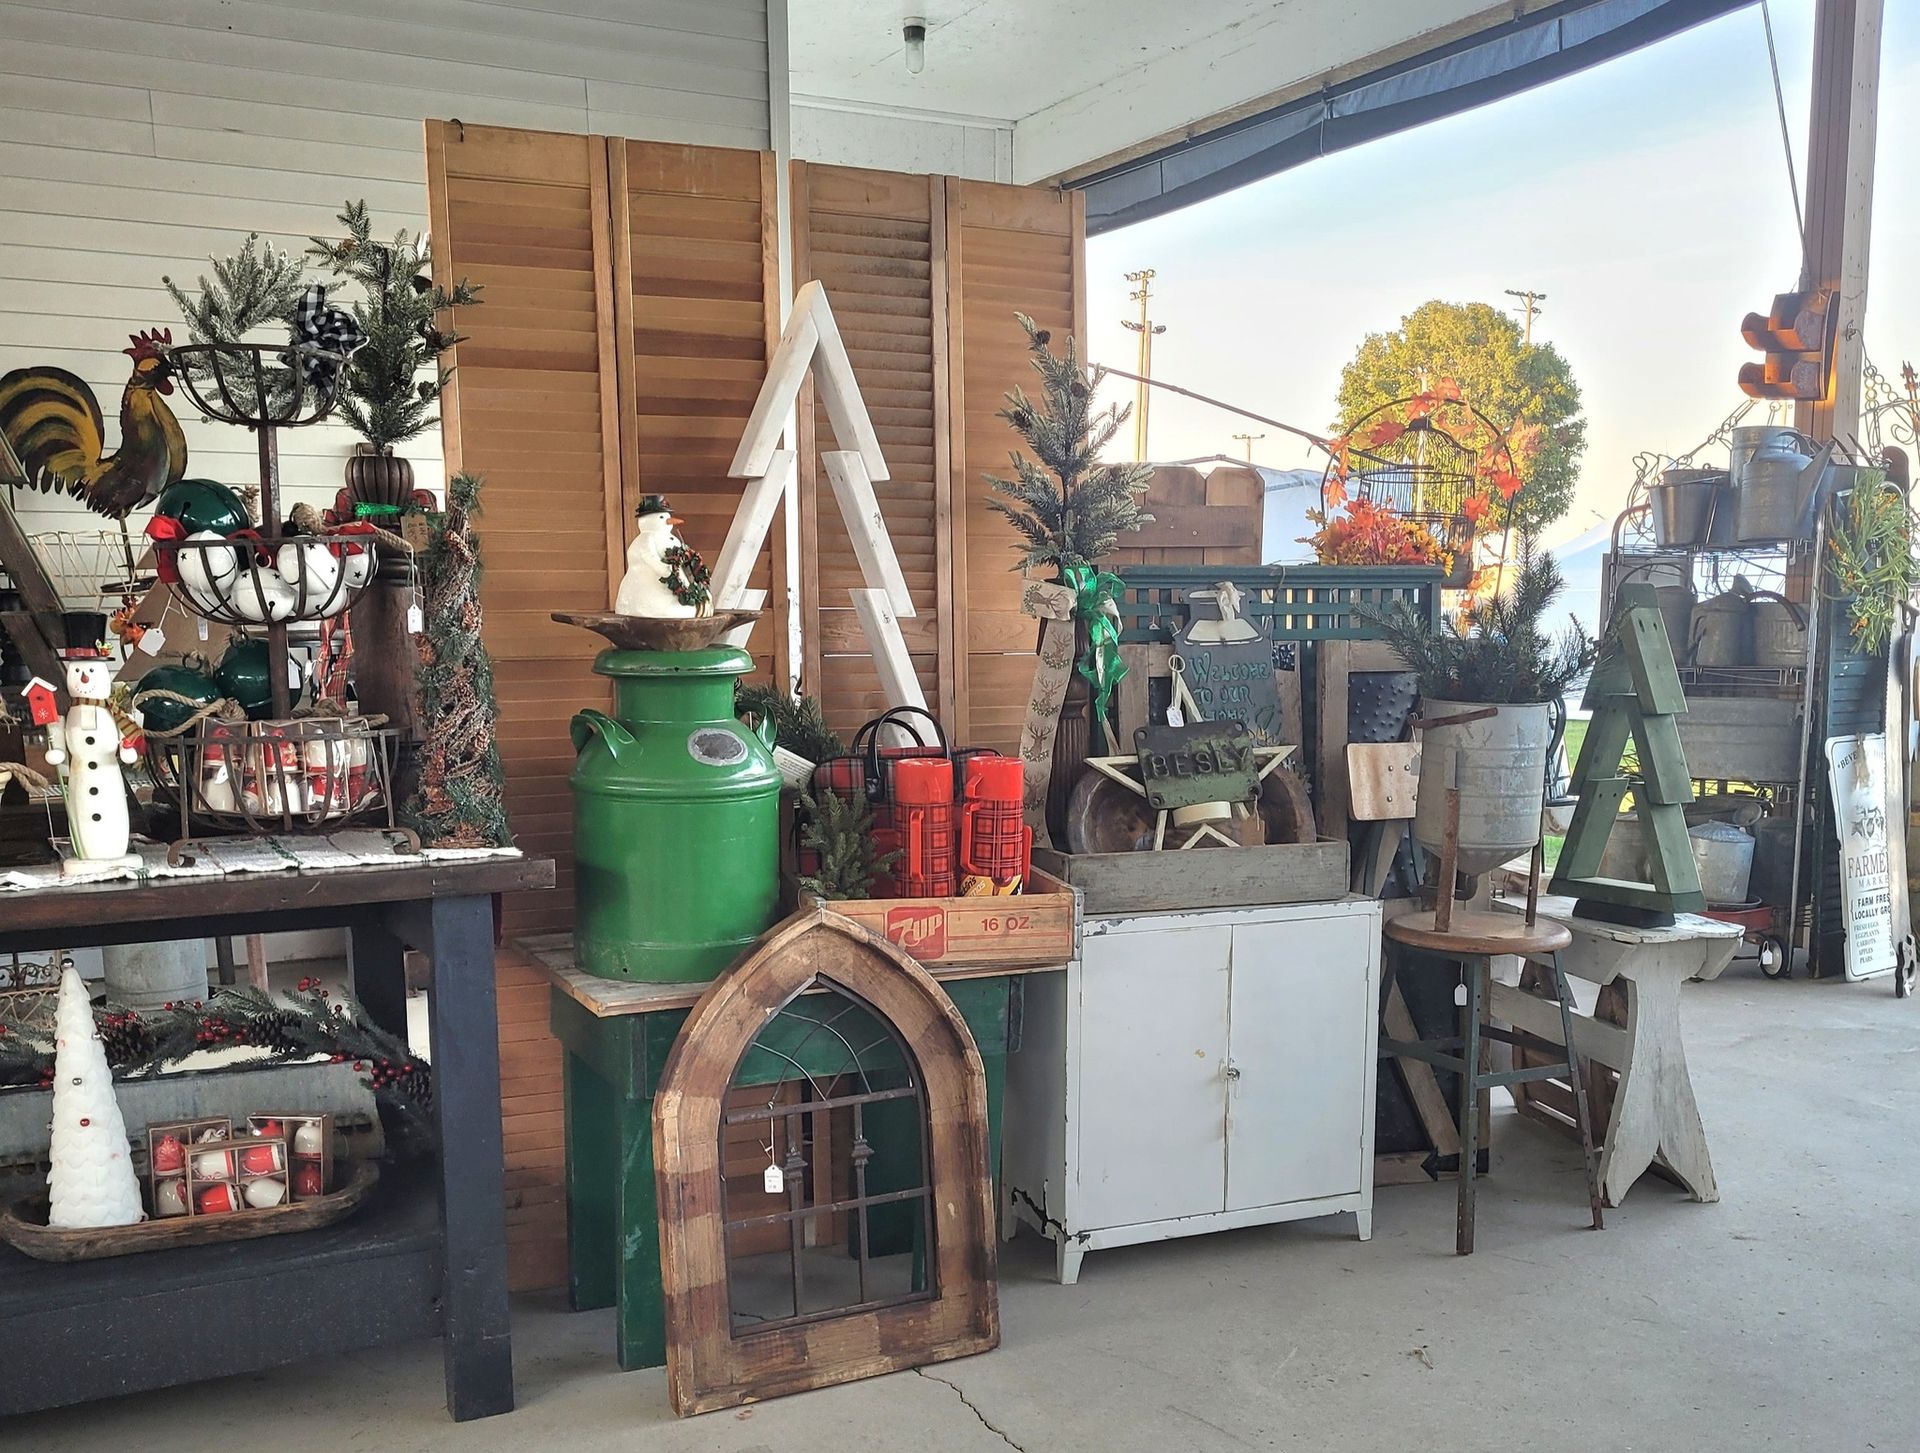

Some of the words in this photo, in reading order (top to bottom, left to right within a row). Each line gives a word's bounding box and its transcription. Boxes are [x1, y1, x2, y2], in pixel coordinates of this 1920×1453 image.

[1220, 685, 1255, 707] OUR
[1151, 740, 1249, 777] BESLY
[1839, 750, 1857, 769] BEVE
[1848, 852, 1888, 879] FARME
[1859, 875, 1889, 888] MARKE
[1857, 896, 1874, 907] FARM
[1876, 893, 1891, 904] FRES
[1855, 908, 1879, 920] LOCALLY
[1880, 905, 1891, 915] GRO
[981, 918, 999, 931] 16
[1005, 916, 1034, 931] OZ.
